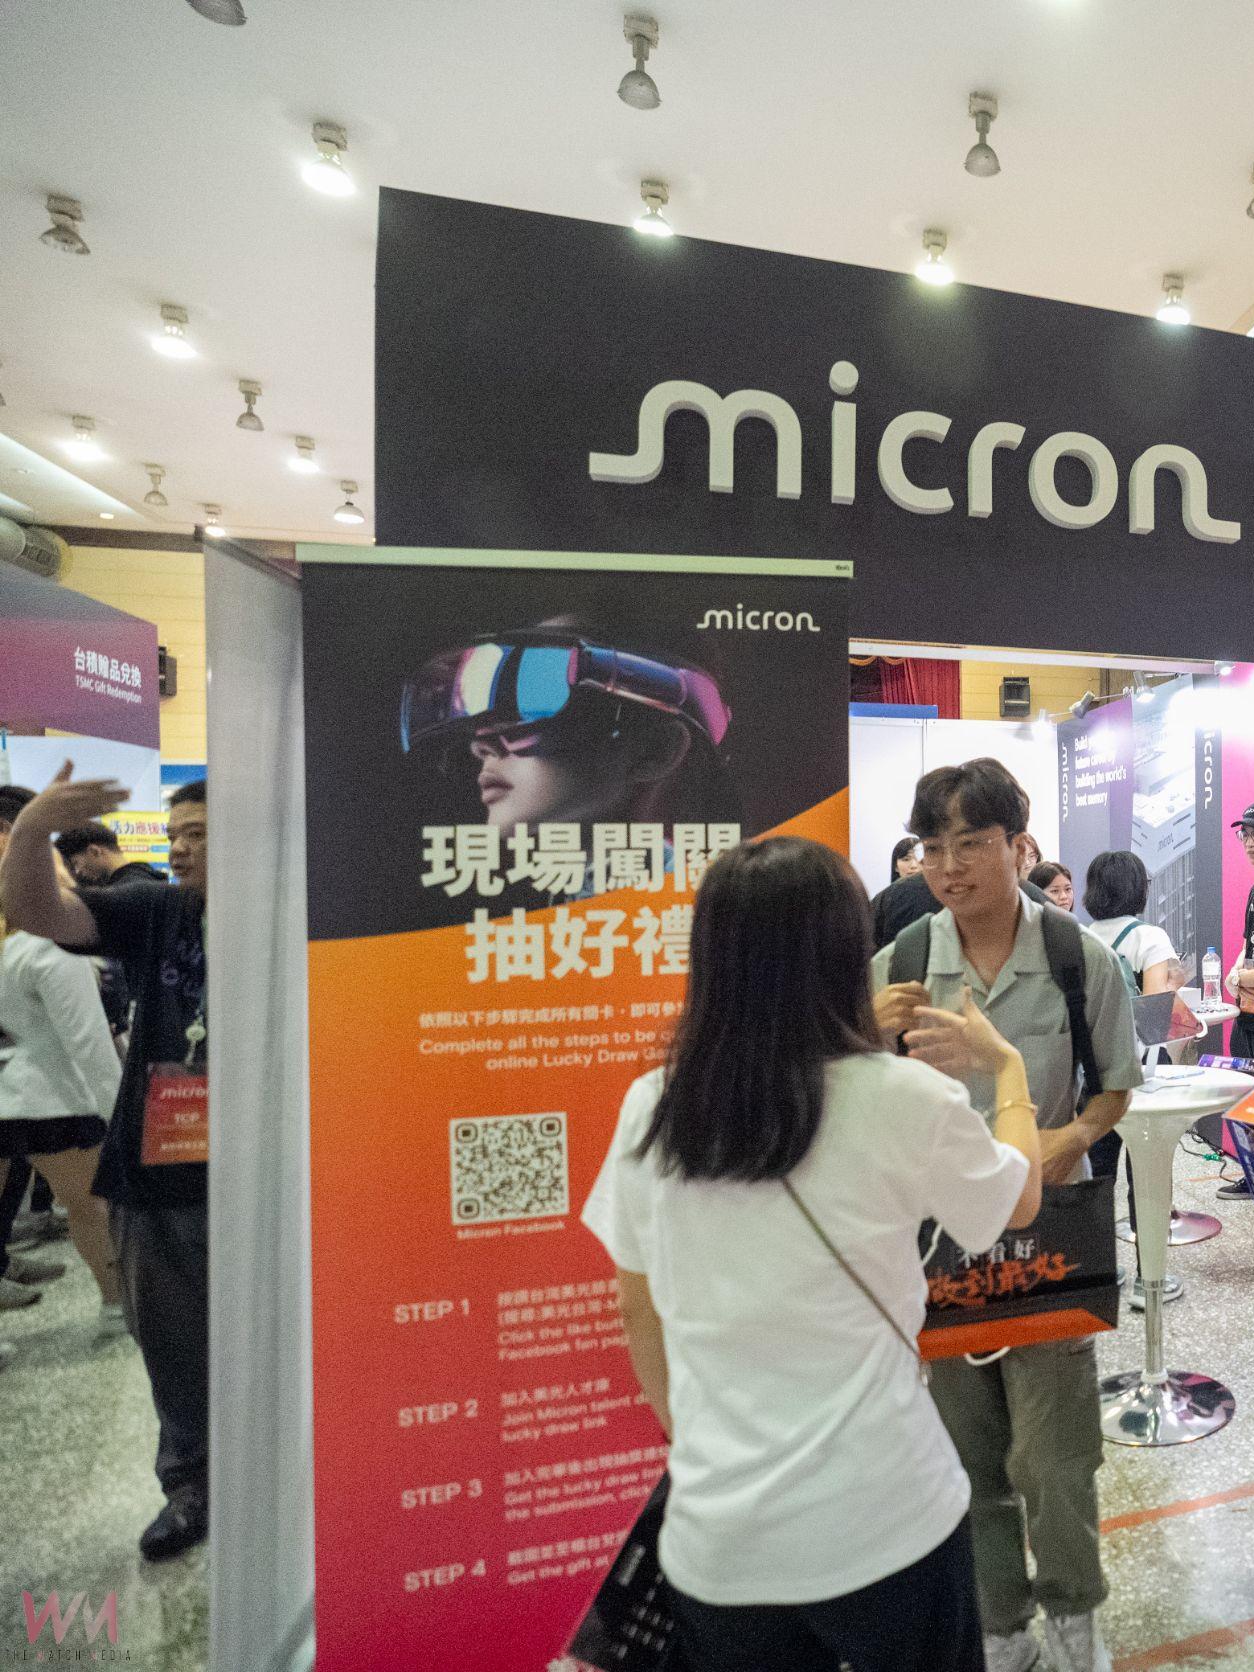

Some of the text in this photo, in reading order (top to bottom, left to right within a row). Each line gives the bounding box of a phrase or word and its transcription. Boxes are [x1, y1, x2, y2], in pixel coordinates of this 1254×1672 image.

[589, 361, 1240, 544] micron
[696, 603, 821, 632] micron
[1062, 742, 1070, 823] micron
[421, 822, 741, 897] 現場闖關
[465, 904, 694, 984] 抽好禮
[419, 1038, 502, 1056] Complete
[508, 1035, 527, 1050] all
[532, 1034, 559, 1049] the
[564, 1034, 609, 1050] steps
[613, 1031, 630, 1044] to
[635, 1029, 656, 1043] be
[486, 1054, 538, 1071] online
[543, 1052, 592, 1069] Lucky
[597, 1049, 638, 1064] Draw
[160, 1087, 208, 1100] micro
[394, 1298, 470, 1324] STEP 1
[399, 1398, 479, 1428] STEP 2
[402, 1478, 483, 1509] STEP 3
[404, 1558, 486, 1593] STEP 4
